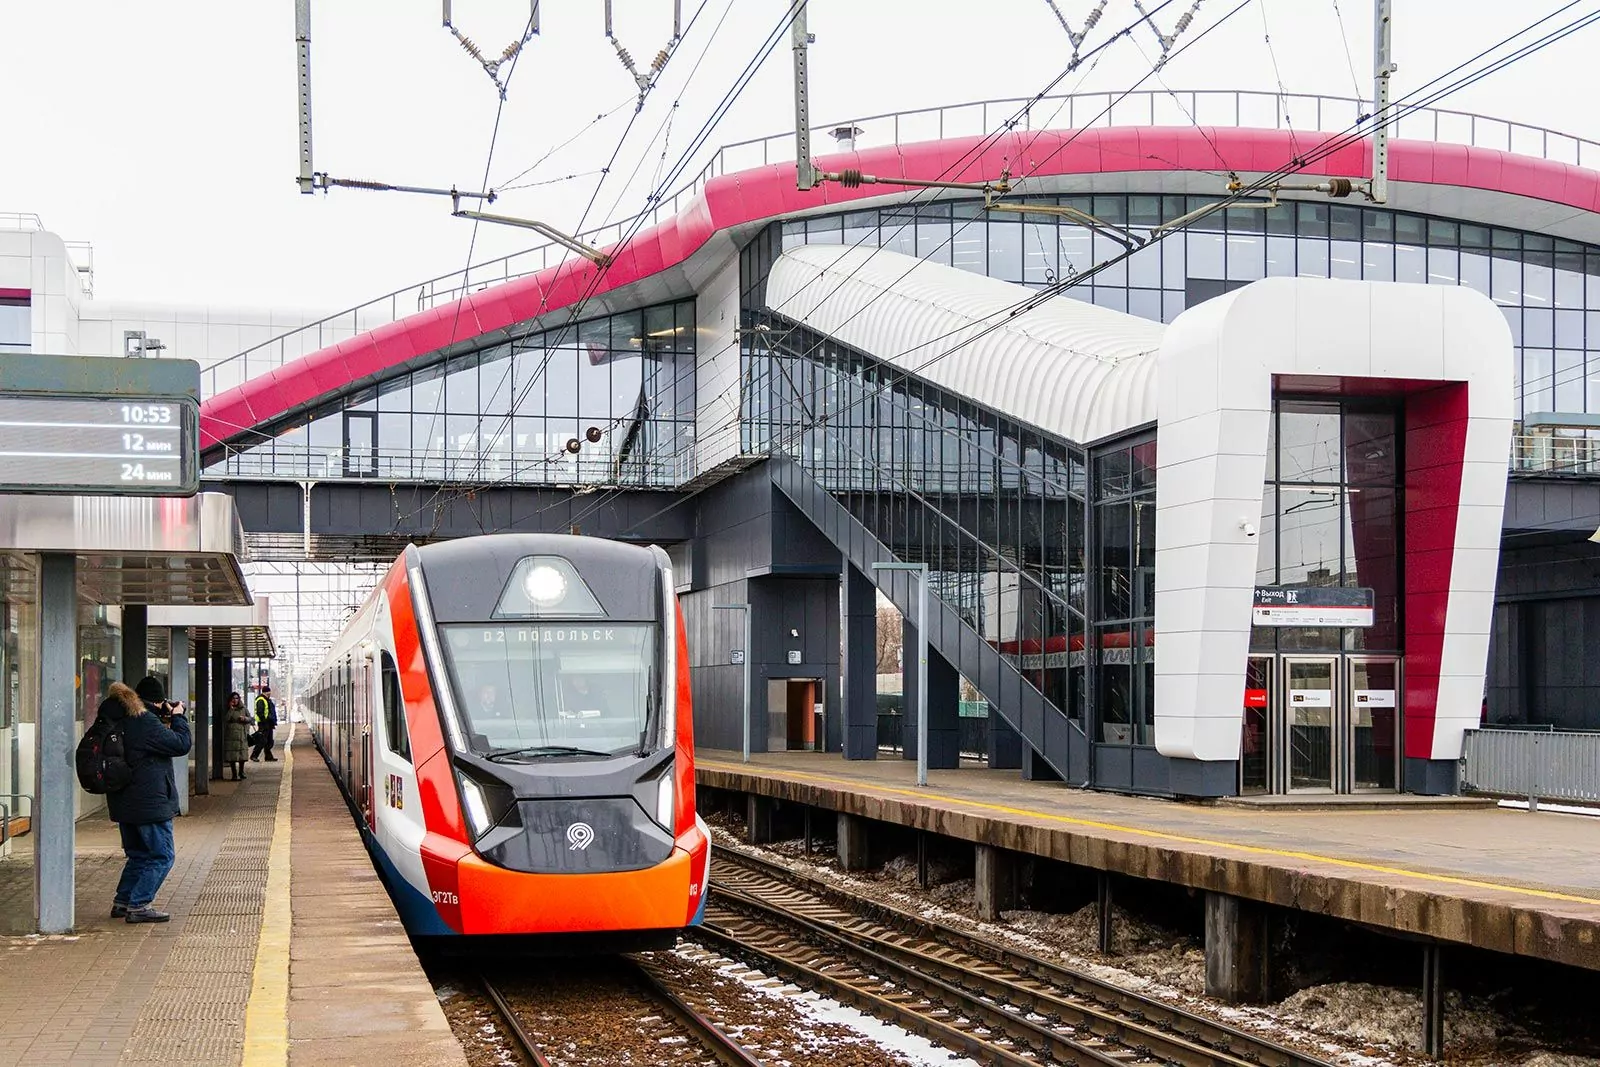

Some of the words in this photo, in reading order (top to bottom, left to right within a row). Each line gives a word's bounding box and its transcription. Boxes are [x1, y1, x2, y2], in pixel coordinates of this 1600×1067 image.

[120, 406, 171, 423] 10:53
[122, 433, 144, 450] 12
[146, 440, 172, 451] мин
[120, 463, 144, 480] 24
[146, 470, 172, 481] мин
[1261, 589, 1285, 599] Выход
[518, 629, 614, 642] ПОДОЛЬСК
